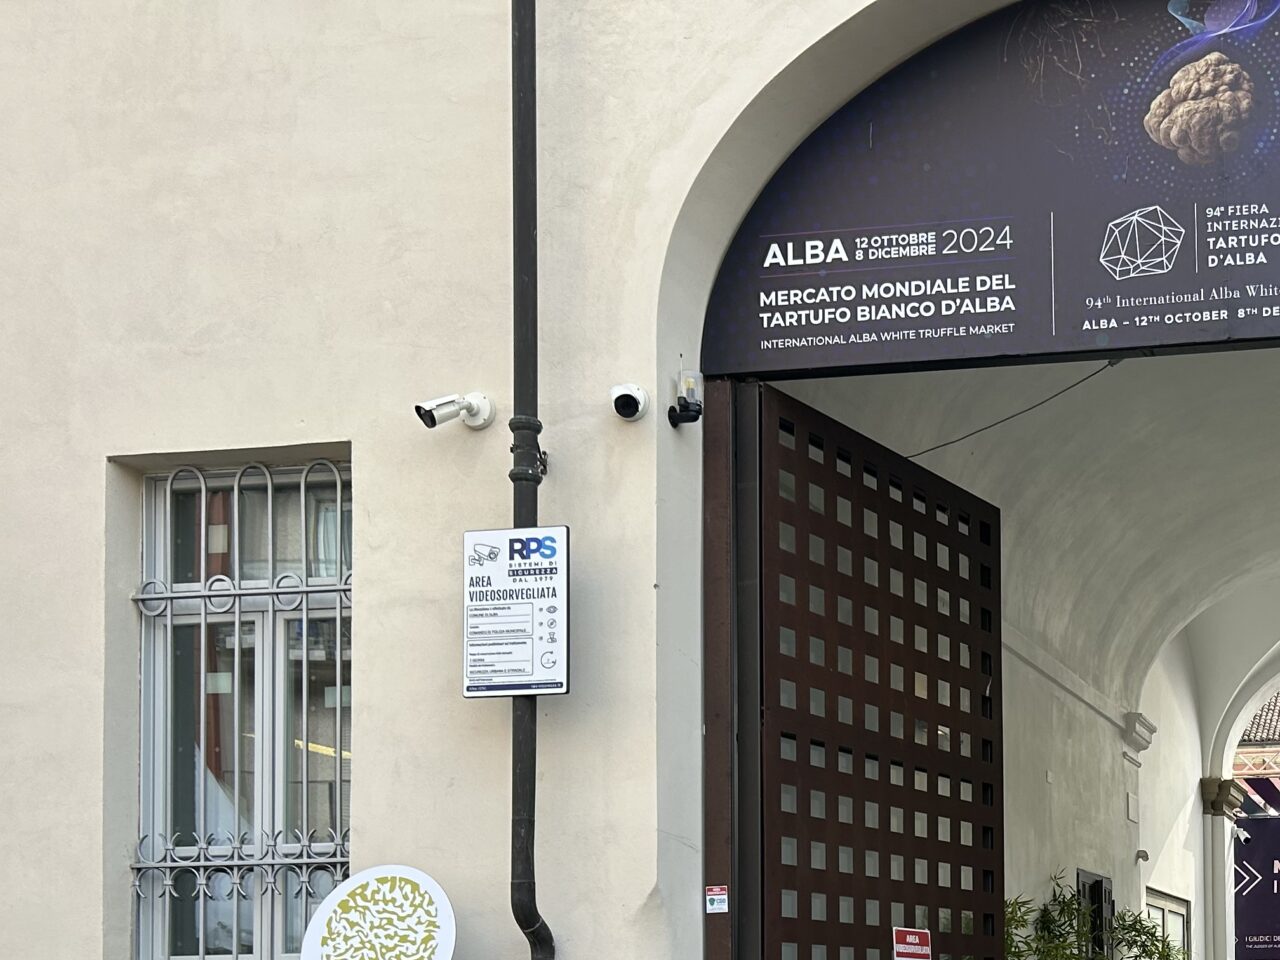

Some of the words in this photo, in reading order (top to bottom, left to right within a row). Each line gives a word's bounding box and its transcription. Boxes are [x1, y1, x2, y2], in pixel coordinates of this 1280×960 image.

[1228, 203, 1269, 216] FIERA
[854, 237, 868, 249] 12
[871, 231, 936, 248] OTTOBRE
[942, 225, 1013, 254] 2024
[763, 238, 849, 268] ALBA
[855, 250, 864, 261] 8
[868, 244, 936, 260] DICEMBRE
[1208, 252, 1267, 267] D'ALBA
[759, 285, 856, 307] MERCATO
[862, 277, 970, 301] MONDIALE
[976, 274, 1016, 291] DEL
[1086, 295, 1111, 310] 94th
[1116, 288, 1204, 307] International
[1209, 286, 1241, 300] Alba
[759, 307, 851, 329] TARTUFO
[857, 301, 936, 322] BIANCO
[1082, 318, 1118, 331] ALBA
[1134, 314, 1160, 327] 12TH
[1164, 310, 1228, 324] OCTOBER
[1237, 306, 1258, 319] 8TH
[760, 334, 847, 350] INTERNATIONAL
[848, 331, 879, 344] ALBA
[880, 329, 916, 342] WHITE
[918, 325, 966, 339] TRUFFLE
[969, 323, 1015, 336] MARKET
[509, 536, 557, 560] RPS
[469, 575, 492, 588] AREA
[469, 586, 557, 602] VIDEOSORVEGLIATA
